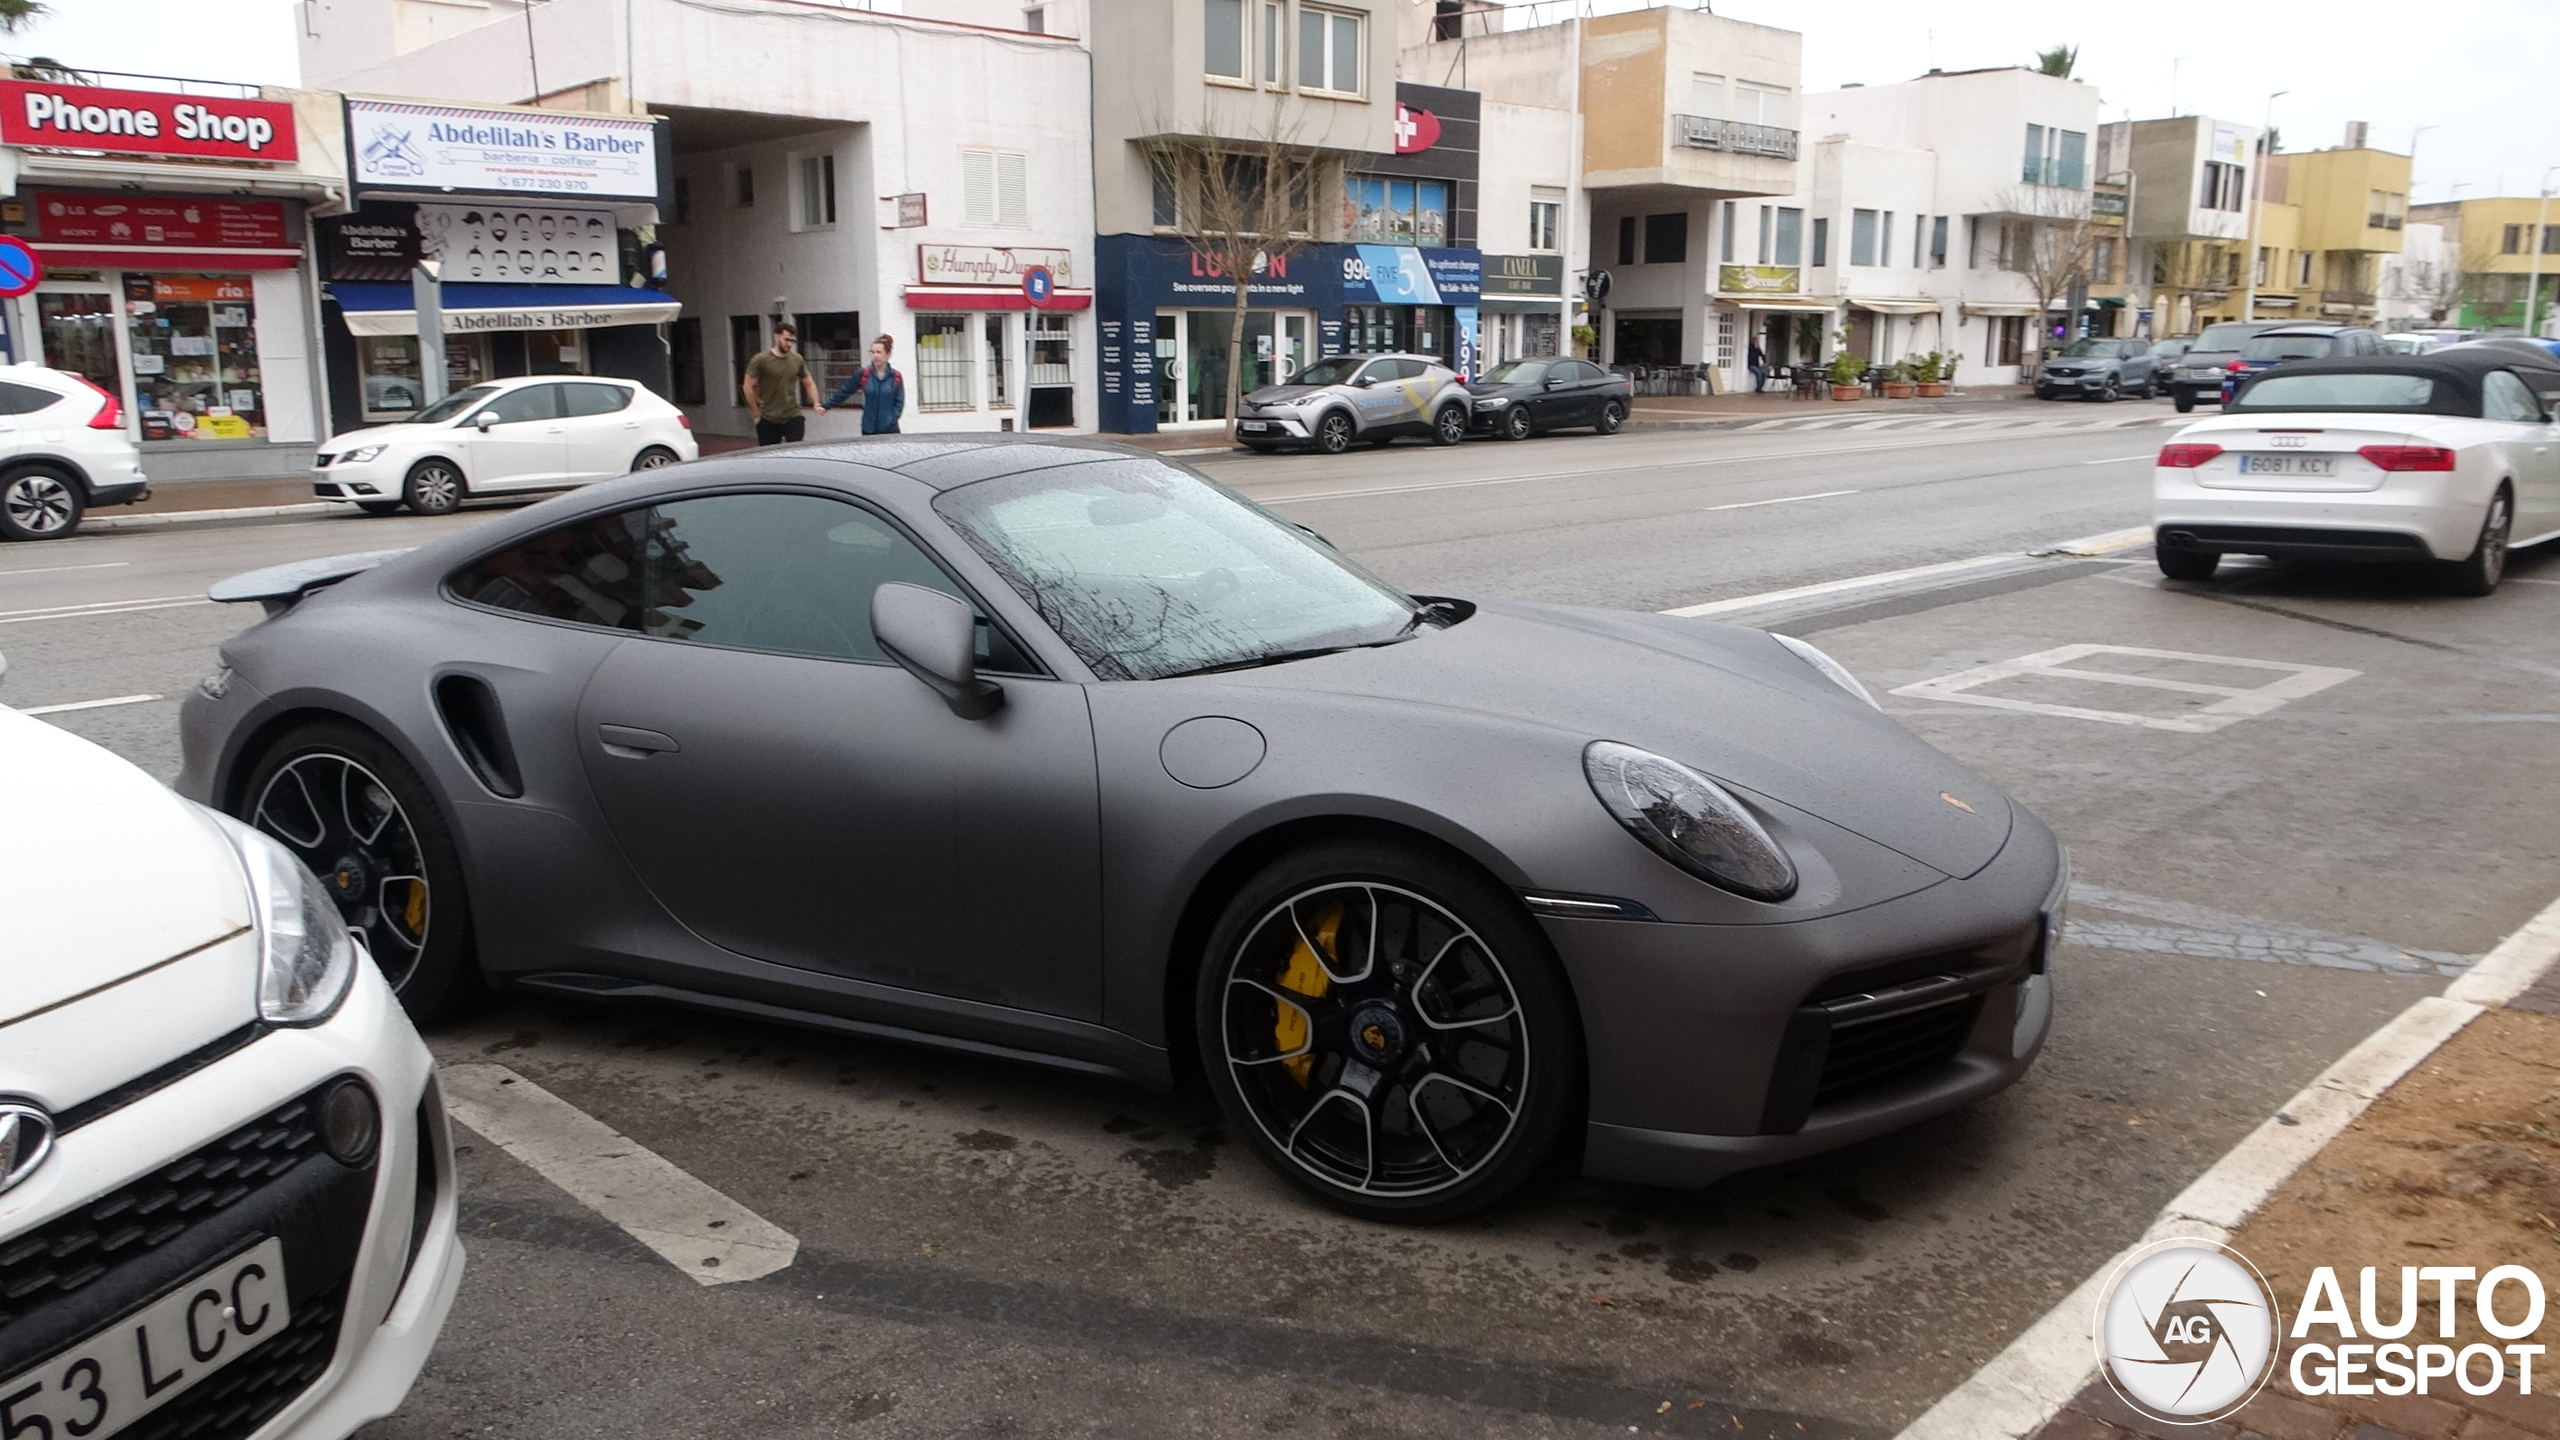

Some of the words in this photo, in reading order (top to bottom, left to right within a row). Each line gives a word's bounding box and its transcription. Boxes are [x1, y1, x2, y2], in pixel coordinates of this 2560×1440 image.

[24, 92, 159, 138] Phone
[173, 103, 273, 150] Shop
[428, 122, 556, 149] Abdelilah's
[564, 131, 645, 155] Barber
[512, 177, 534, 188] 677
[538, 178, 561, 190] 230
[565, 180, 588, 191] 970
[60, 229, 100, 237] SONY
[339, 225, 408, 237] Abdelilah's
[350, 237, 398, 249] Barber
[941, 248, 997, 282] Humpty
[1343, 258, 1372, 281] 99€
[1376, 265, 1399, 280] FIVE
[1397, 254, 1416, 296] 5
[217, 282, 244, 298] ria
[1173, 282, 1187, 292] See
[452, 312, 545, 330] Abdelilah's
[552, 311, 612, 326] Barber
[2251, 457, 2292, 473] 6081
[2300, 458, 2334, 473] KCY
[136, 1263, 271, 1399] LCC
